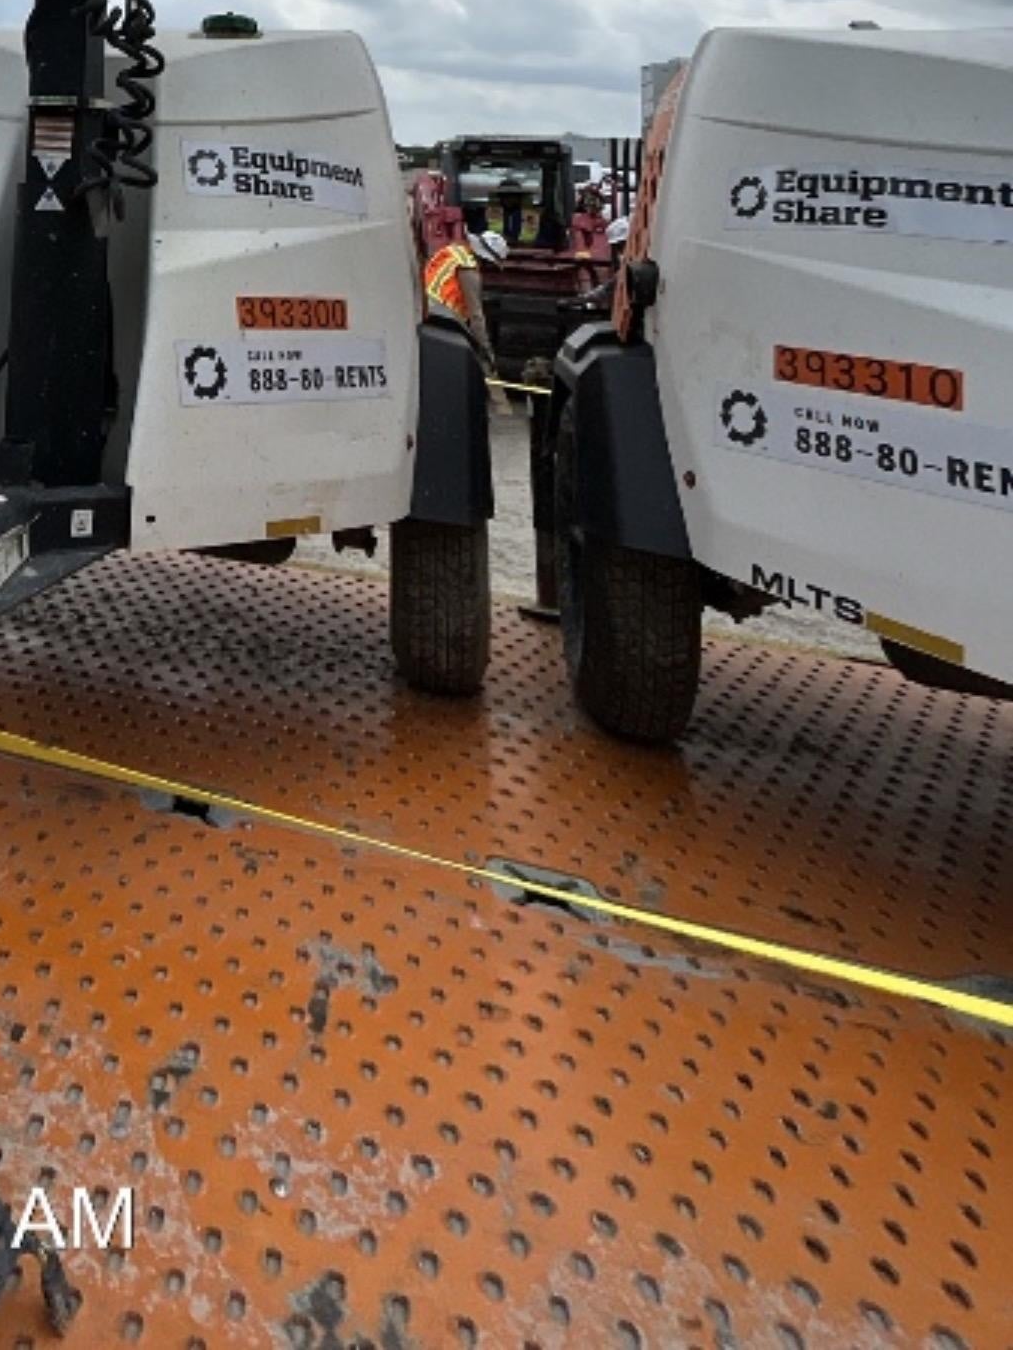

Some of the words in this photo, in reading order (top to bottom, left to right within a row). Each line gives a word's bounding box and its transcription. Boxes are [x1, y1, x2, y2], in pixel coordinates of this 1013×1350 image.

[230, 146, 365, 187] Equipment
[233, 173, 315, 201] Share
[775, 169, 1013, 208] Equipment
[772, 199, 888, 228] Share
[239, 297, 347, 329] 393300
[777, 347, 959, 409] 393310
[841, 414, 880, 434] NOW
[751, 562, 864, 626] MLTS
